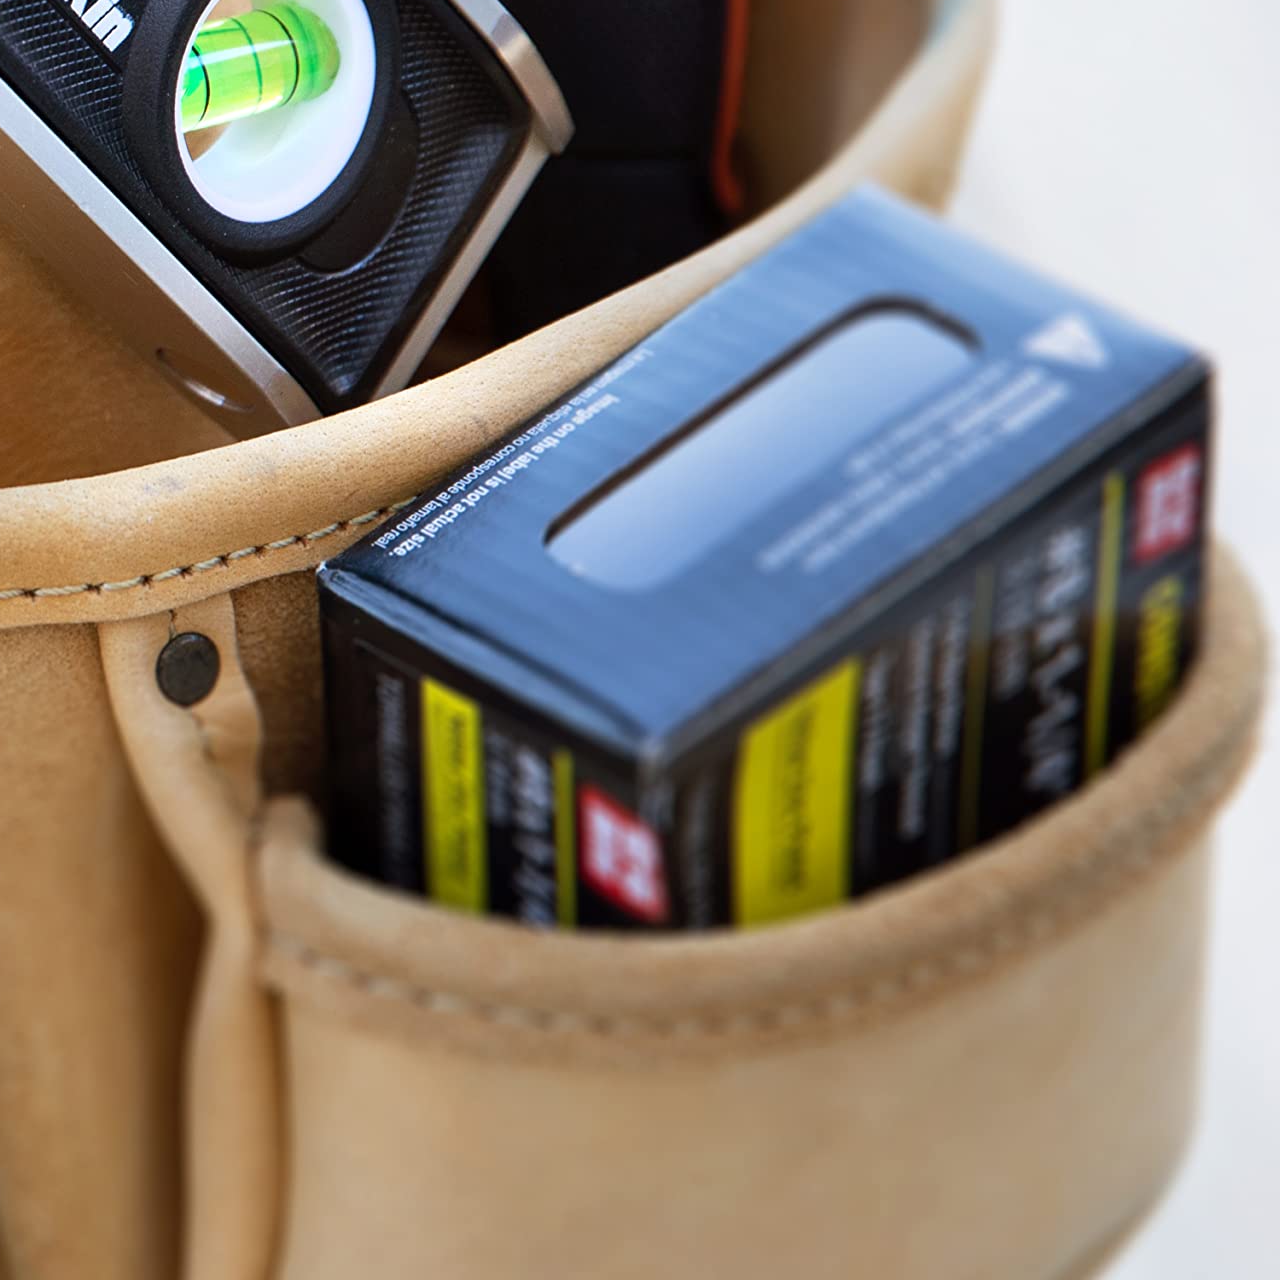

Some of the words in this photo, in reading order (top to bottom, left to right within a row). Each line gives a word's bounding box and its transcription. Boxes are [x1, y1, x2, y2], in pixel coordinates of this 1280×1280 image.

[512, 433, 531, 447] no
[552, 422, 575, 438] on
[531, 435, 561, 454] the
[447, 444, 516, 494] corresponde
[497, 452, 539, 480] label
[485, 476, 507, 488] is
[436, 491, 451, 504] al
[460, 485, 489, 507] not
[396, 500, 443, 531] tamaño
[421, 503, 466, 538] actual
[371, 529, 399, 549] real.
[389, 533, 425, 556] size.
